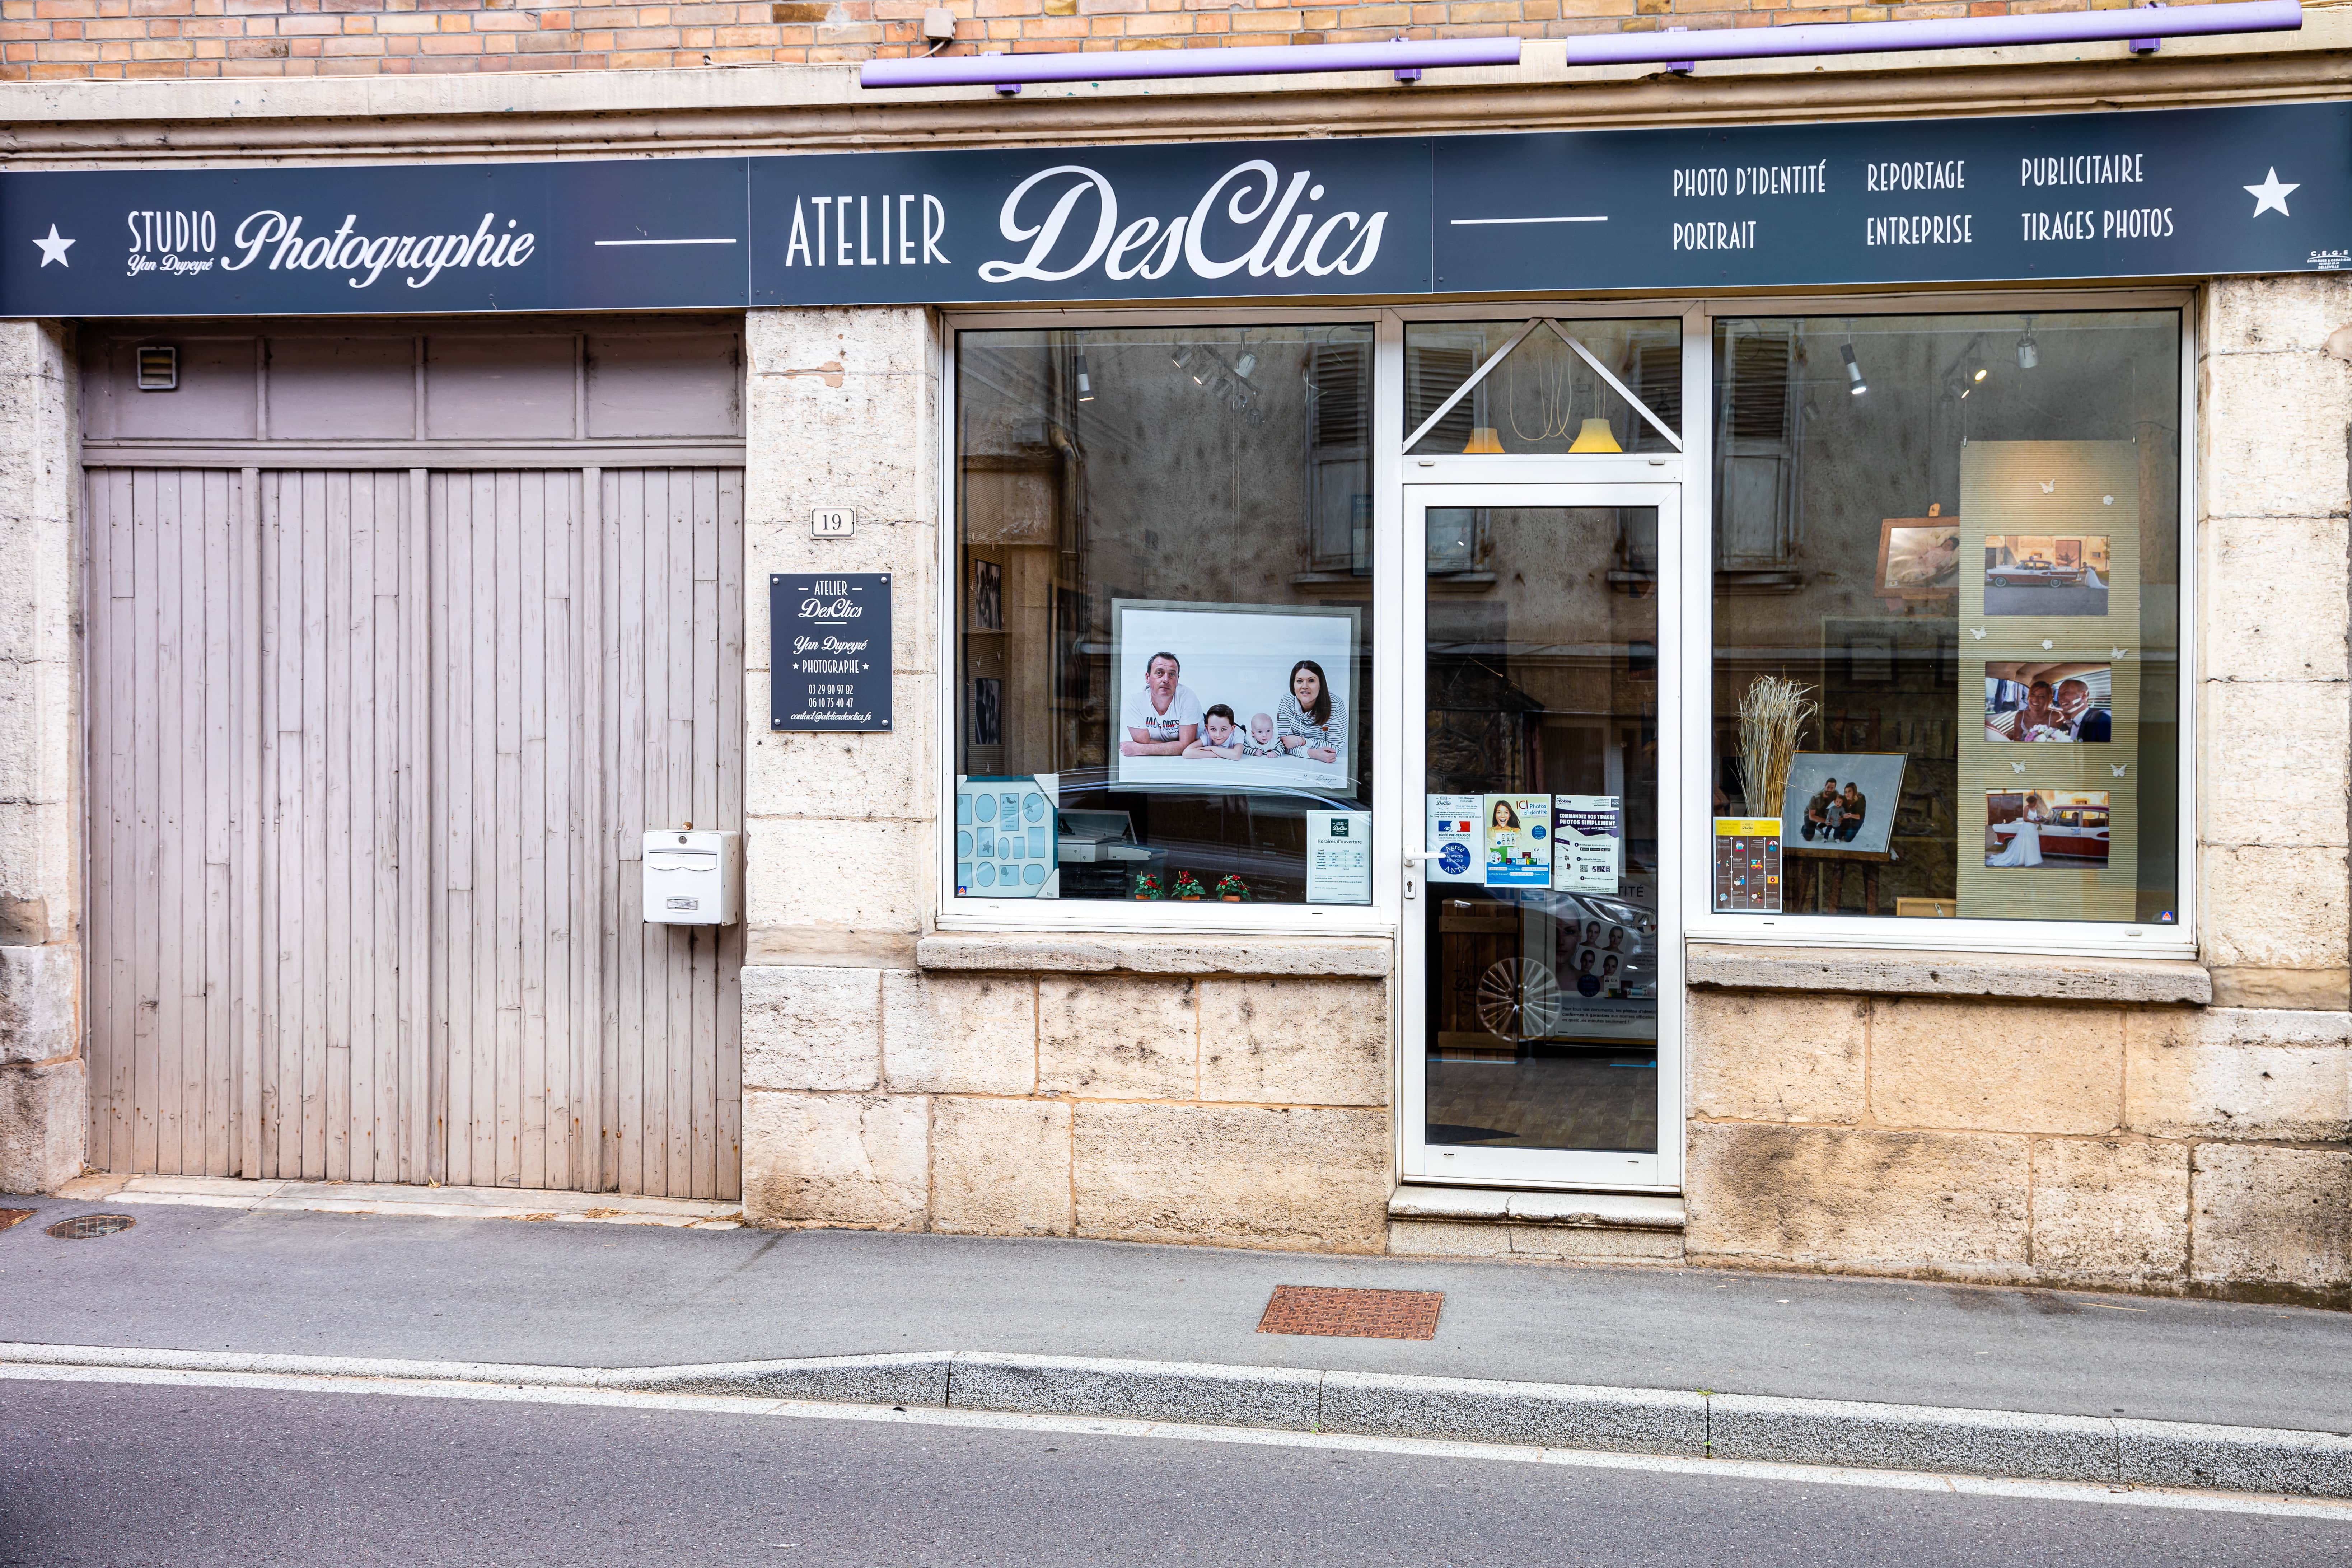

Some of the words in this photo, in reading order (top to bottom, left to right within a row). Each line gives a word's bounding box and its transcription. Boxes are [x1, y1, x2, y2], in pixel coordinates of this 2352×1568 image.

[1674, 168, 1727, 197] PHOTO
[1736, 159, 1827, 195] D'IDENTITÉ
[1868, 160, 1965, 191] REPORTAGE
[2022, 154, 2143, 186] PUBLICITAIRE
[785, 194, 951, 267] ATELIER
[978, 159, 1388, 283] DesClics
[1867, 215, 1972, 245] ENTREPRISE
[2021, 210, 2095, 241] TIRAGES
[2104, 207, 2173, 238] PHOTOS
[1674, 221, 1756, 250] PORTRAIT
[128, 210, 216, 253] STUDIO
[221, 210, 535, 288] Photographie
[127, 254, 157, 276] Yan
[159, 254, 215, 276] Dupeyré
[823, 514, 841, 530] 19
[814, 580, 848, 595] ATELIER
[798, 598, 862, 618] DesClics
[793, 636, 819, 655] Yan
[821, 636, 867, 654] Dupeyré
[803, 659, 859, 673] PHOTOGRAPHE
[809, 684, 816, 694] 03
[818, 684, 826, 694] 29
[827, 684, 835, 694] 80
[837, 684, 844, 694] 97
[846, 684, 853, 694] 82
[809, 697, 817, 707] 06
[819, 698, 825, 708] 10
[827, 698, 834, 708] 75
[836, 698, 844, 708] 40
[846, 698, 853, 708] 47
[790, 711, 872, 723] contact@atelierdesclics.fr
[1516, 800, 1528, 809] ICI
[1444, 865, 1467, 873] ANTS
[1615, 884, 1644, 897] TITÉ
